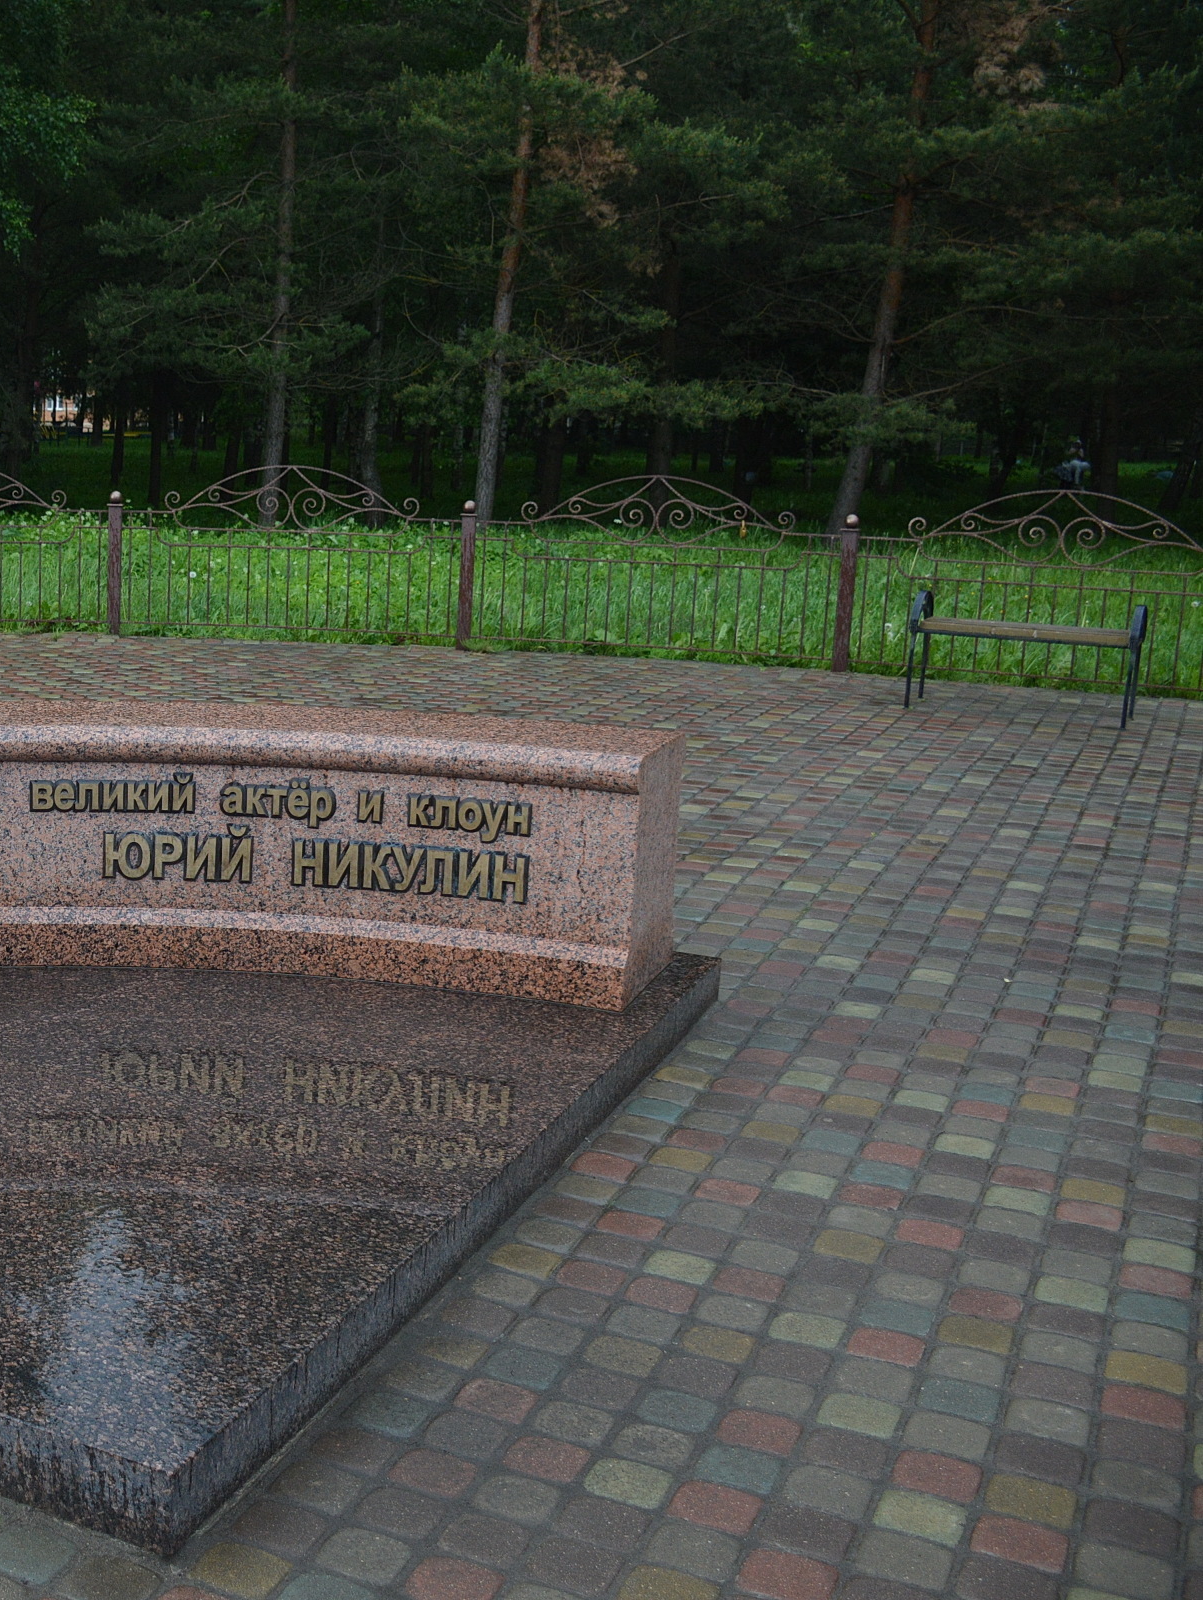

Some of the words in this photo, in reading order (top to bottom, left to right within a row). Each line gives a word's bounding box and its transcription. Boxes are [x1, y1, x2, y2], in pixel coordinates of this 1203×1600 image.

[29, 773, 196, 813] великий
[220, 777, 336, 828] актёр
[356, 790, 384, 824] и
[408, 793, 532, 842] клоун
[101, 824, 254, 883] ЮРИЙ
[291, 837, 530, 904] НИКУЛИН
